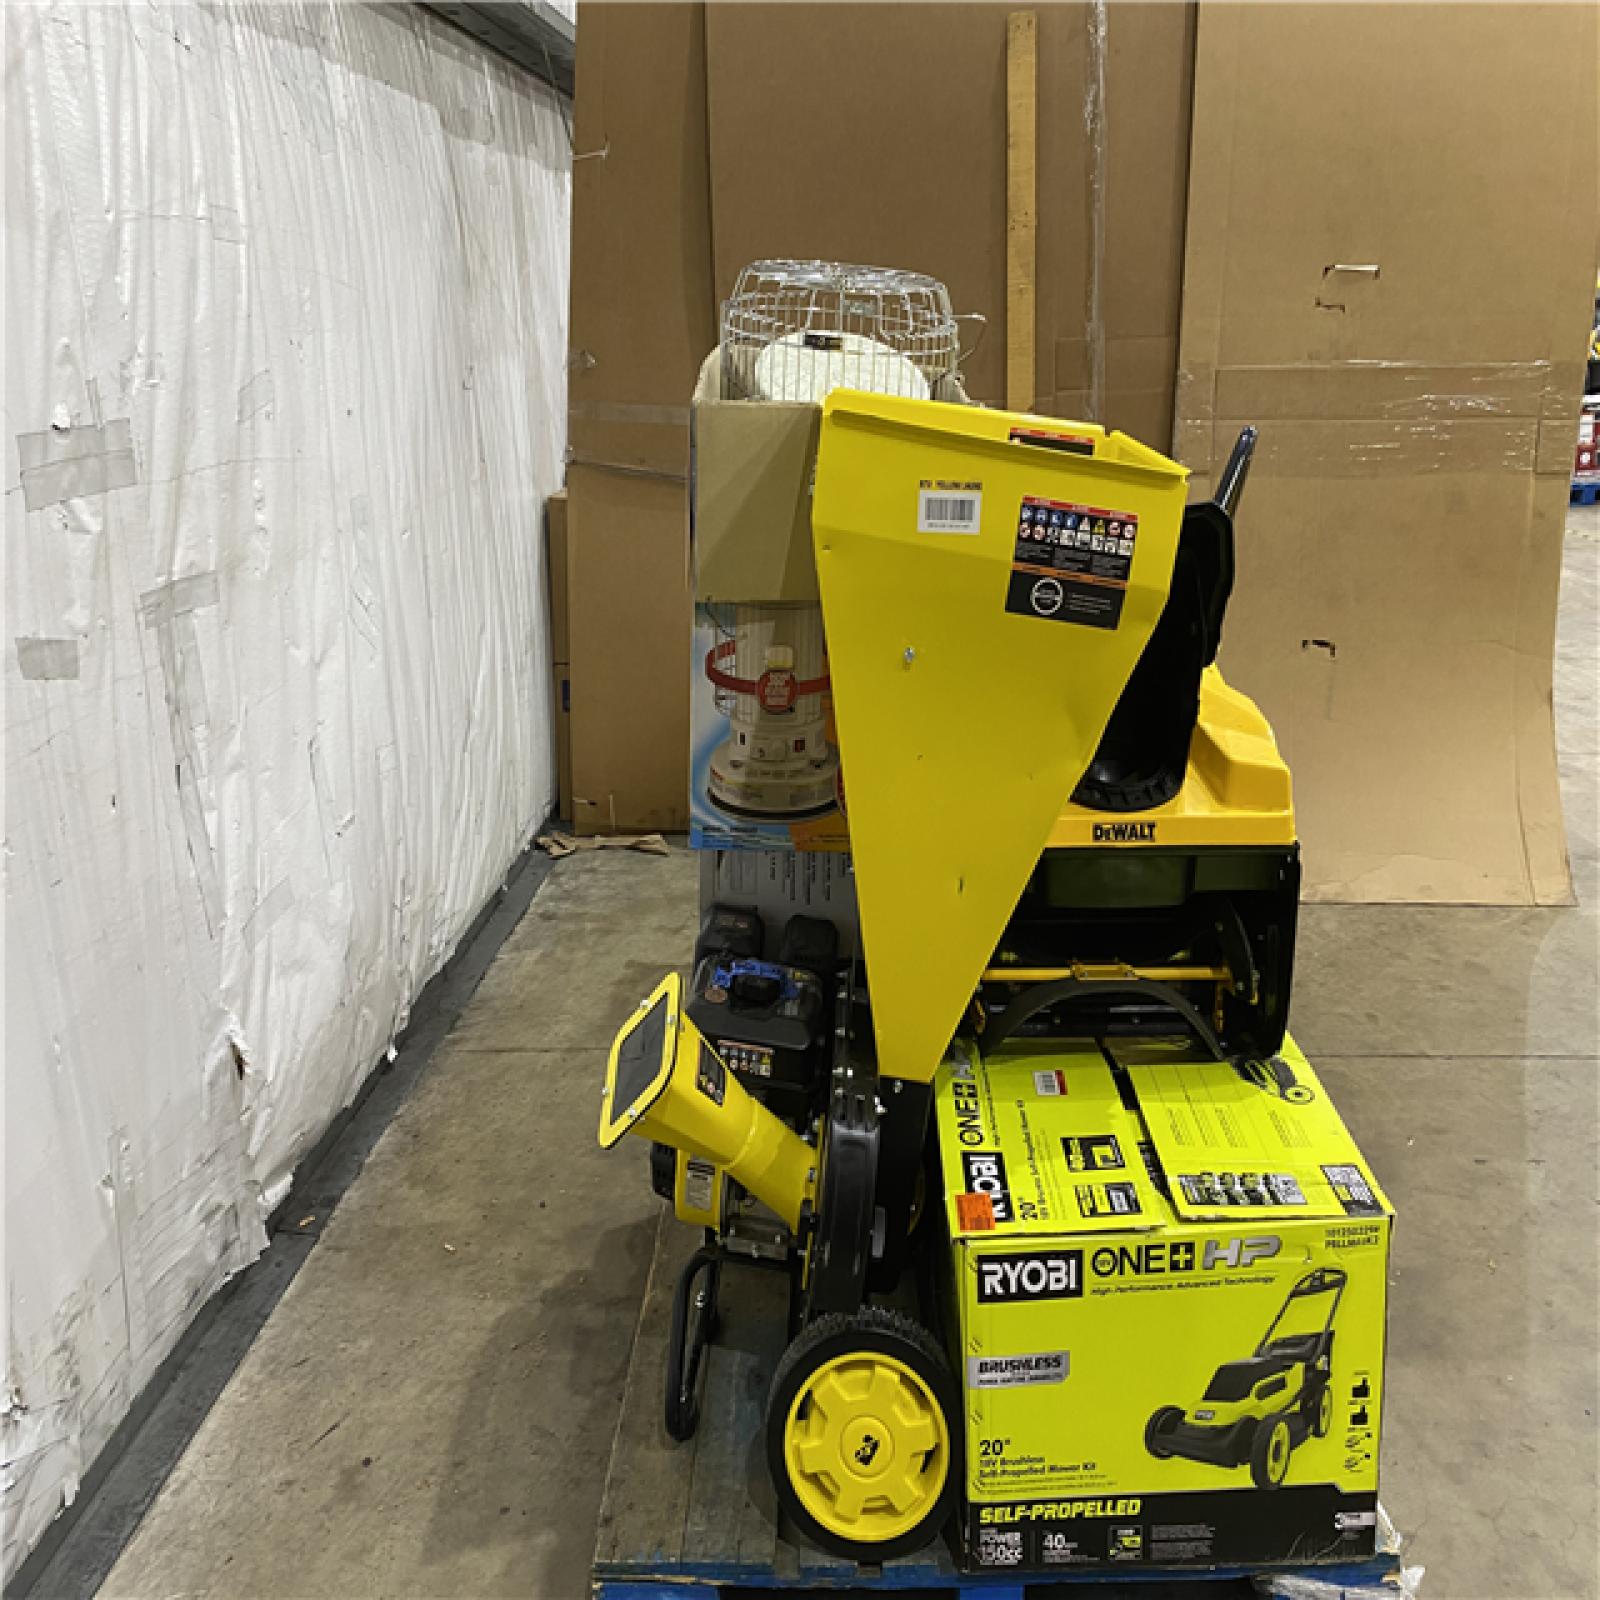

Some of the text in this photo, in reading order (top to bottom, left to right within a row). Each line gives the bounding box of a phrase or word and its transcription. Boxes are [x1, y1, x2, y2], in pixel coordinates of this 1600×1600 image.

[1203, 1235, 1281, 1271] HP
[981, 1258, 1077, 1298] RYOBI
[979, 1499, 1141, 1524] SELF-PROPELLED
